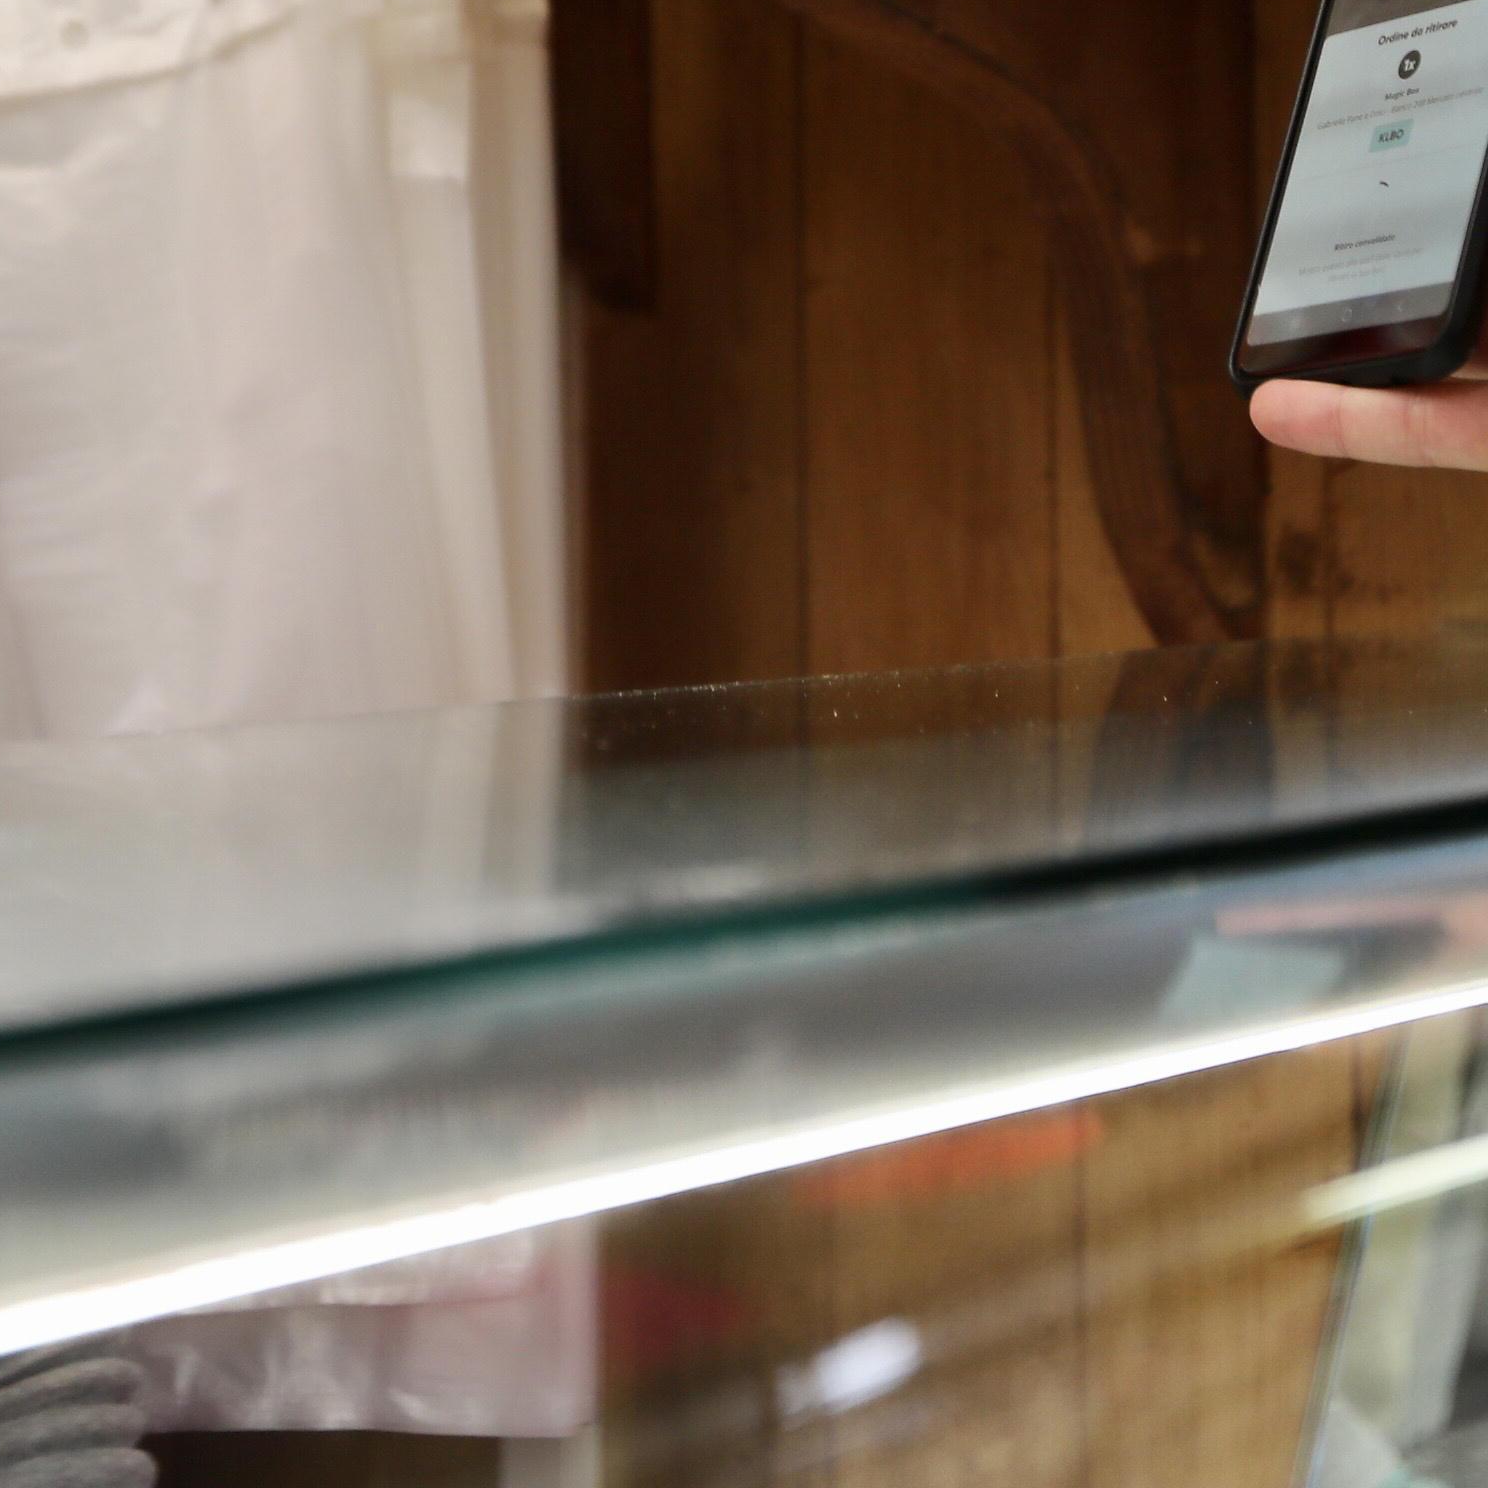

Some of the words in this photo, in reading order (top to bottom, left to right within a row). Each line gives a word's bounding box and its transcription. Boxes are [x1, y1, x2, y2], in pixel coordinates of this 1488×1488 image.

[1378, 30, 1410, 46] Ordine
[1410, 26, 1424, 38] da
[1424, 18, 1459, 34] ritirare
